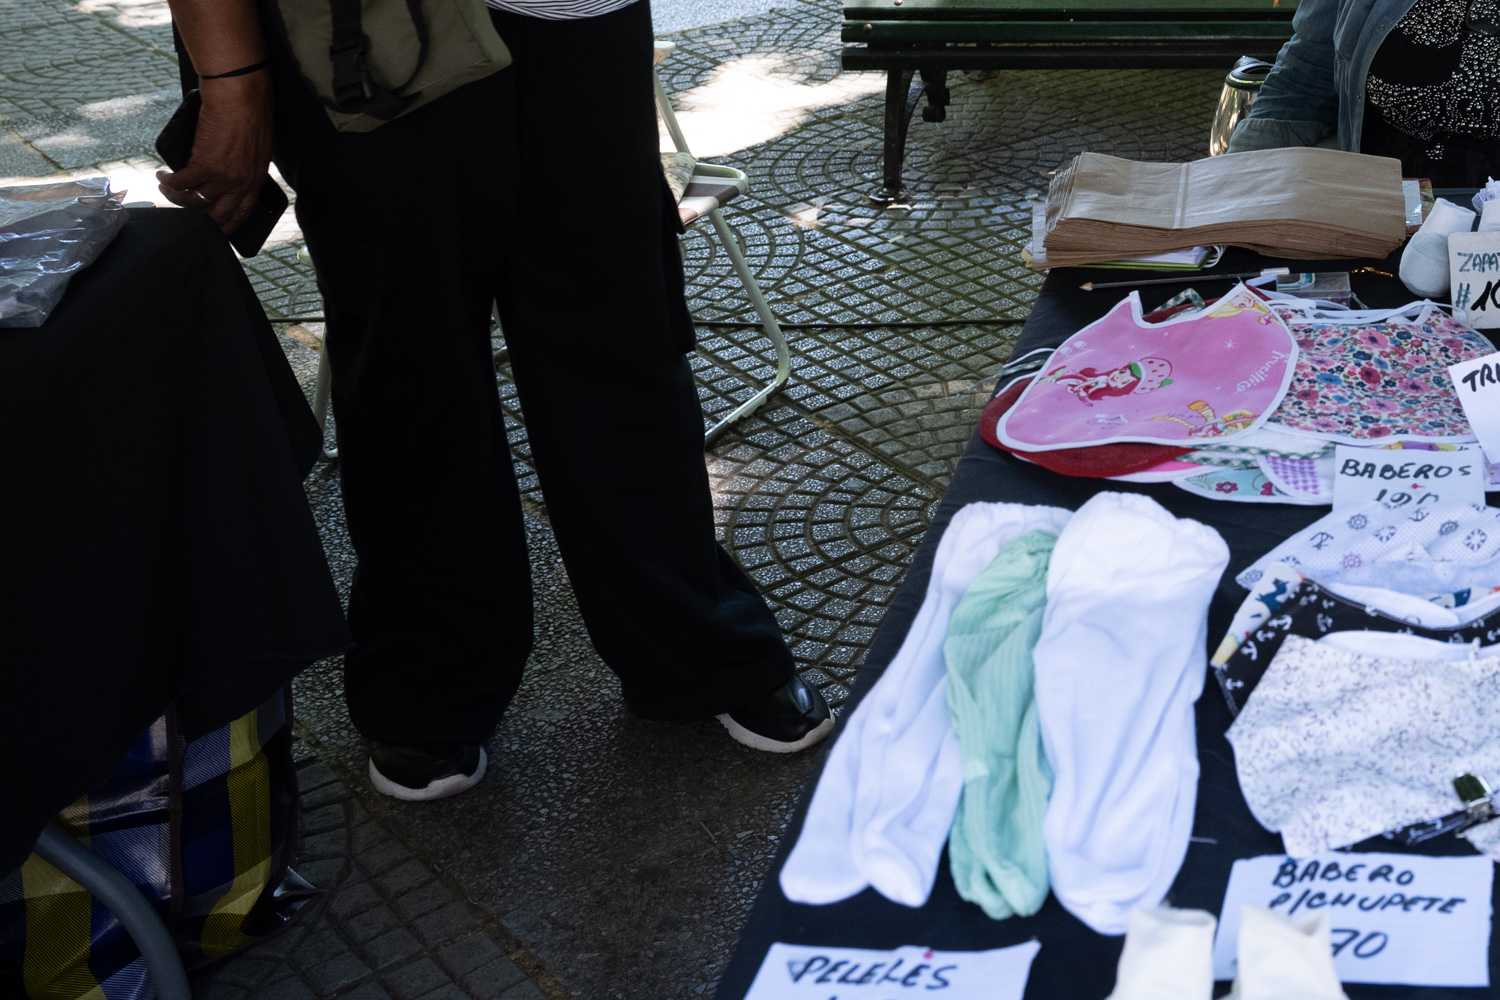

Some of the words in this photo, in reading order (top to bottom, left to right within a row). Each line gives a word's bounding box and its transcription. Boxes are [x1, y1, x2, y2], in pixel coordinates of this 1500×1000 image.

[1340, 458, 1472, 480] BABEROS
[1272, 860, 1415, 888] BABERO
[788, 955, 957, 990] PELELES
